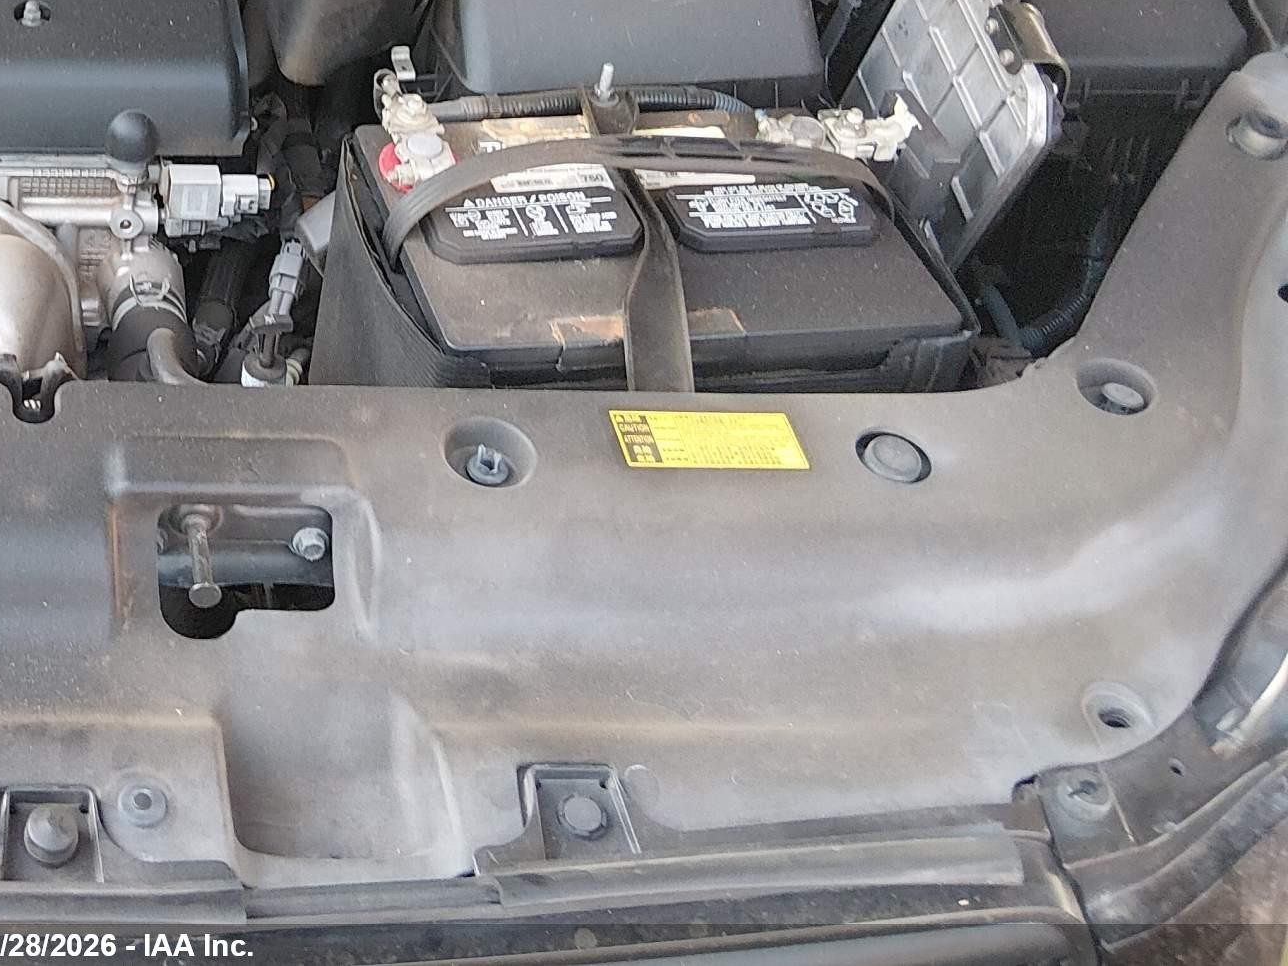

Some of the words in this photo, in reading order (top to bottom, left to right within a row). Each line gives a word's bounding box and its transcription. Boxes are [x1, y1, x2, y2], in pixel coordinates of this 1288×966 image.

[475, 195, 528, 208] DANGER
[537, 191, 588, 204] POISON
[619, 423, 651, 433] CAUTION
